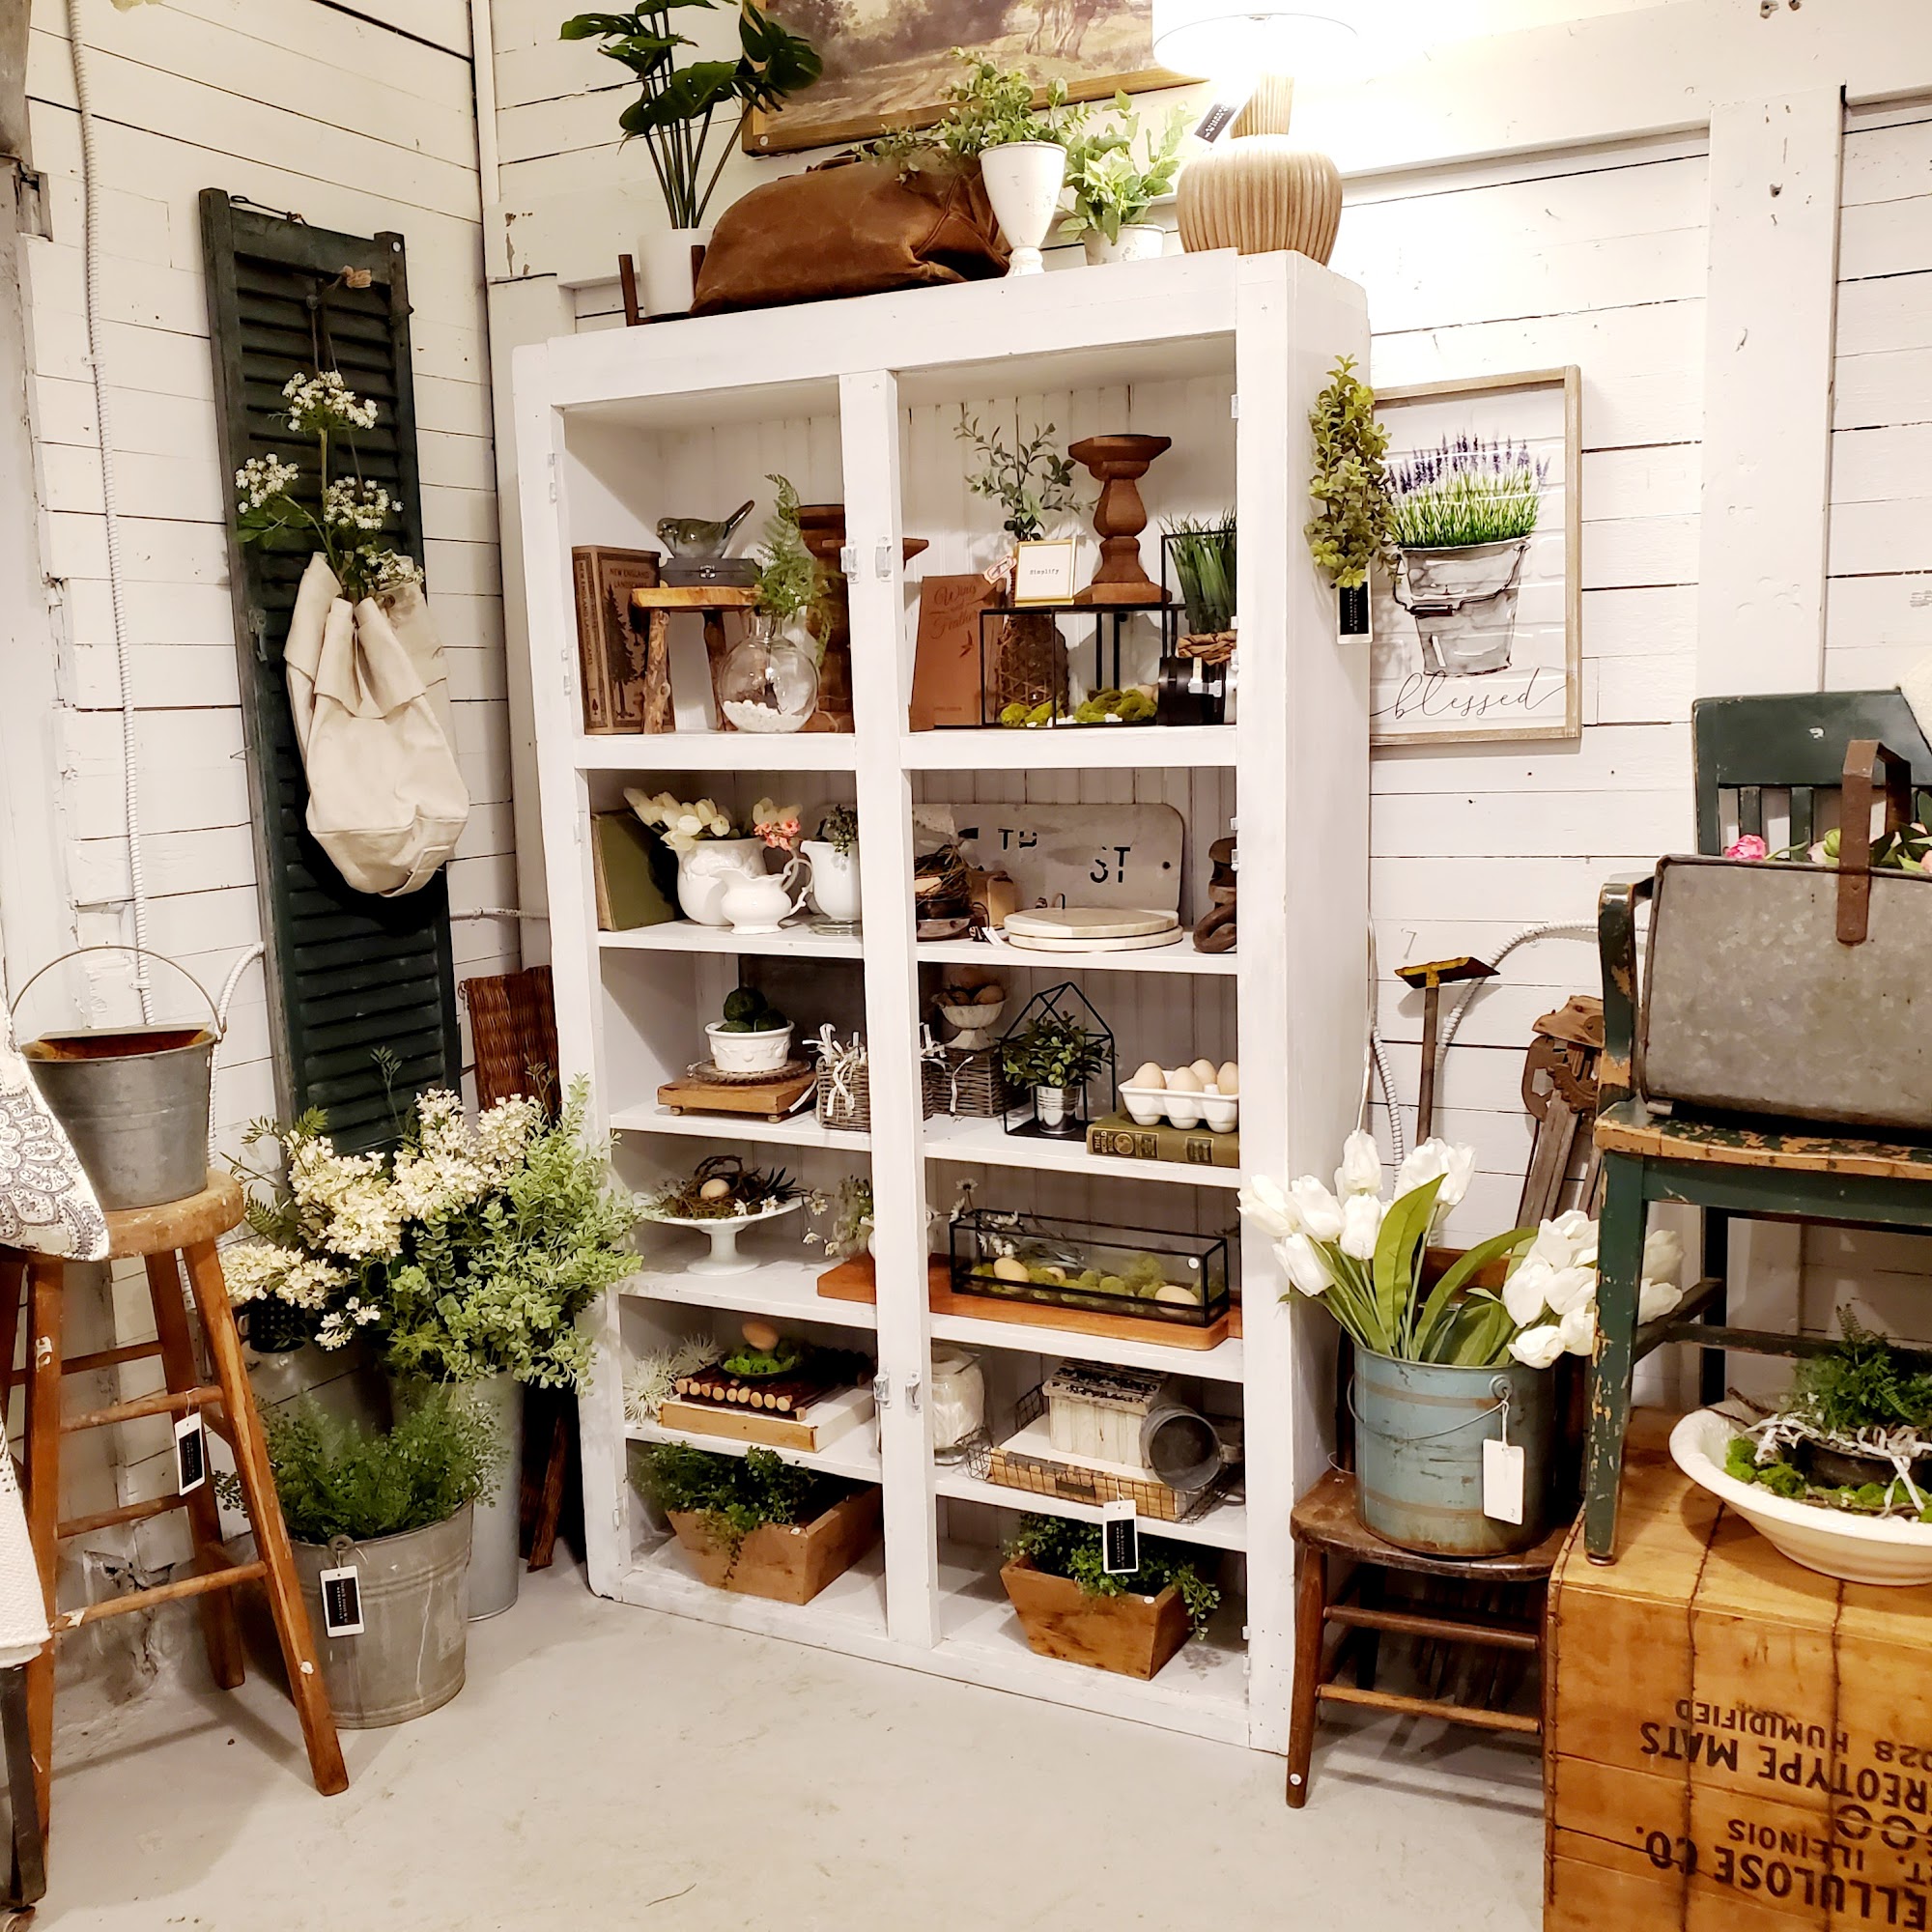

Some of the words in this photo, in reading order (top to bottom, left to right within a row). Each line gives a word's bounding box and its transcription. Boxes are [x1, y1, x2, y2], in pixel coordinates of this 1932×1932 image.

[609, 567, 623, 578] NEW
[1371, 668, 1567, 720] blessed
[1639, 1721, 1738, 1773] MATS
[1675, 1698, 1849, 1754] HUMIDIFIED
[1758, 1745, 1932, 1816] REOTYPE
